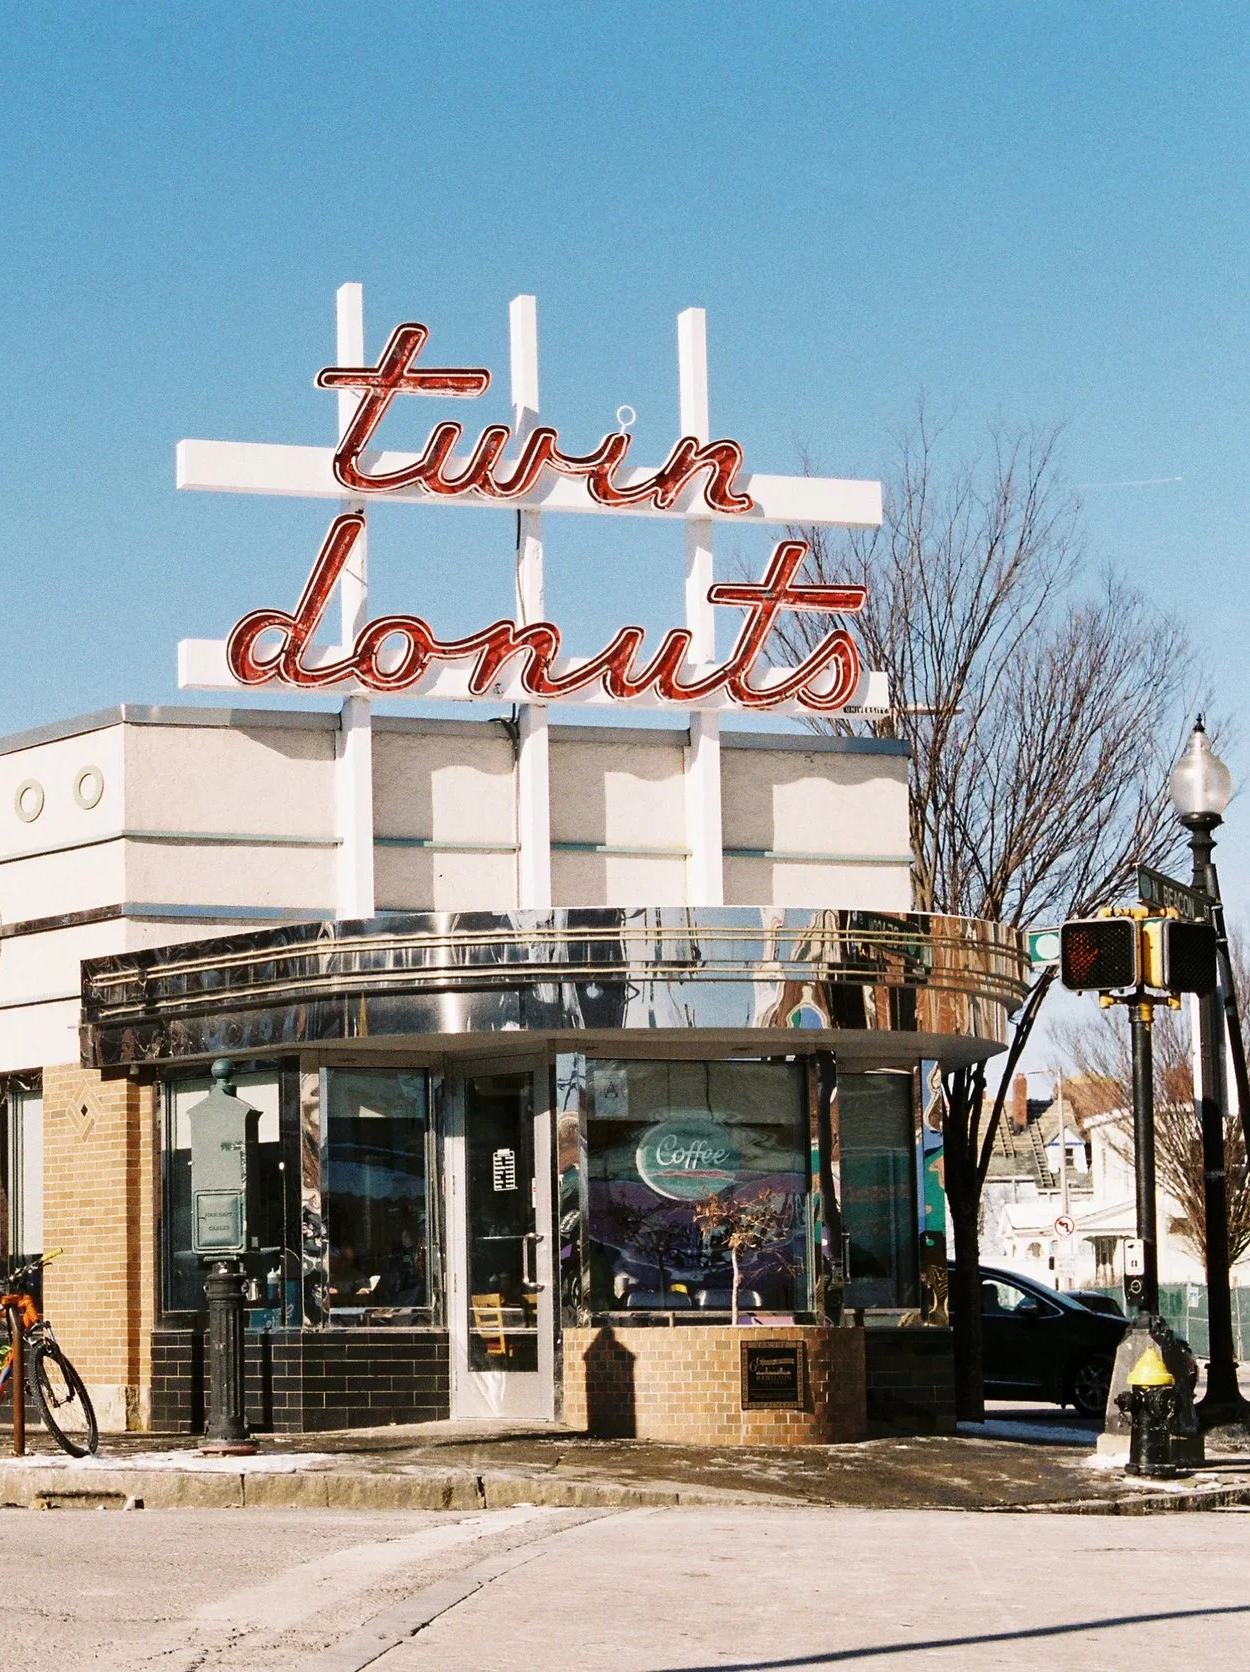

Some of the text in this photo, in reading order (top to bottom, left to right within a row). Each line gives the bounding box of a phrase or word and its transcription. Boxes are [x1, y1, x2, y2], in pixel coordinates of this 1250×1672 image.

[314, 322, 754, 513] twin
[226, 512, 870, 710] donuts
[656, 1134, 731, 1169] Coffee
